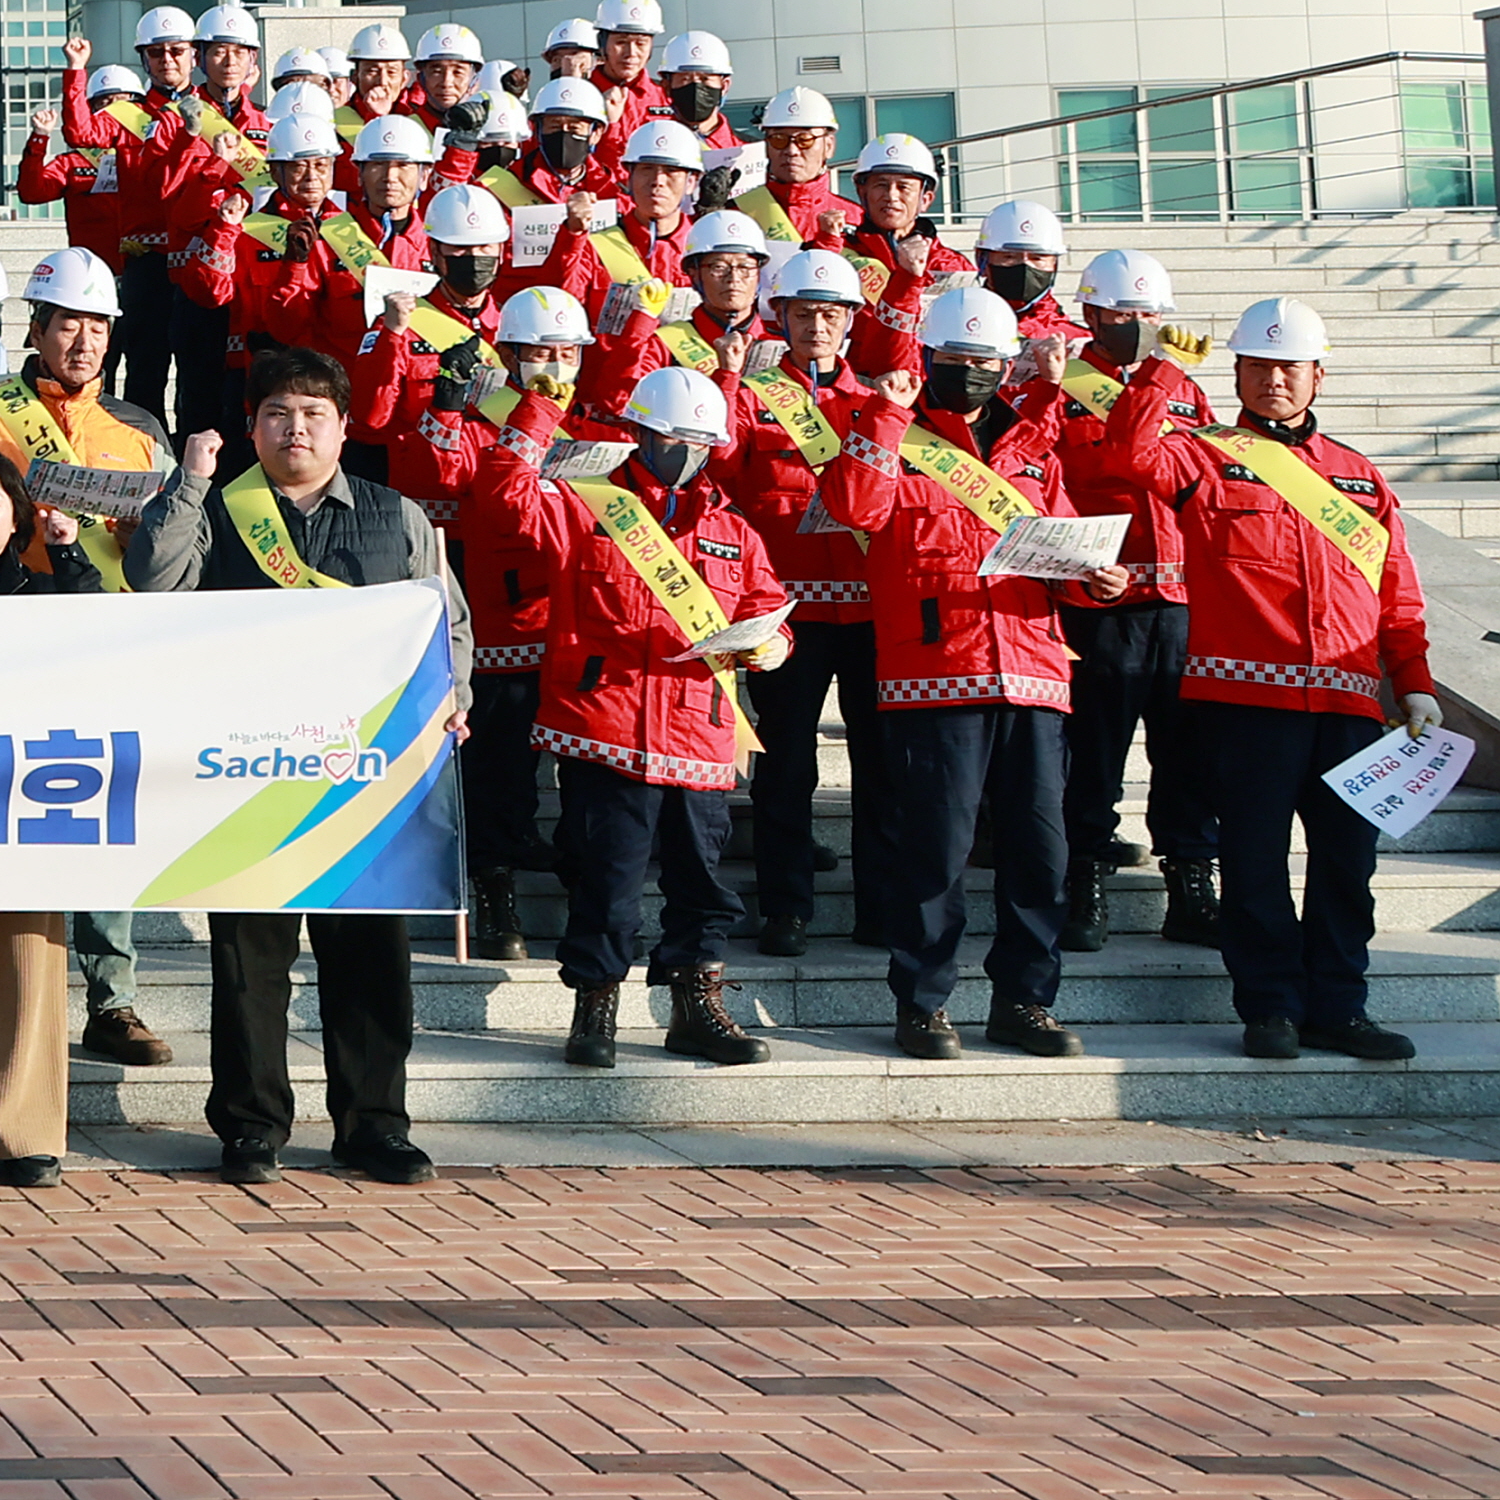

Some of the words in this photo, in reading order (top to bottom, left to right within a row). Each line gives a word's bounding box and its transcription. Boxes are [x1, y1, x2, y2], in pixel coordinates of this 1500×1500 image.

[919, 440, 991, 499] 산림안전
[249, 517, 300, 585] 산림안전
[605, 496, 664, 562] 산림안전
[1403, 741, 1455, 794] 산림안전
[1370, 794, 1405, 819] 실천
